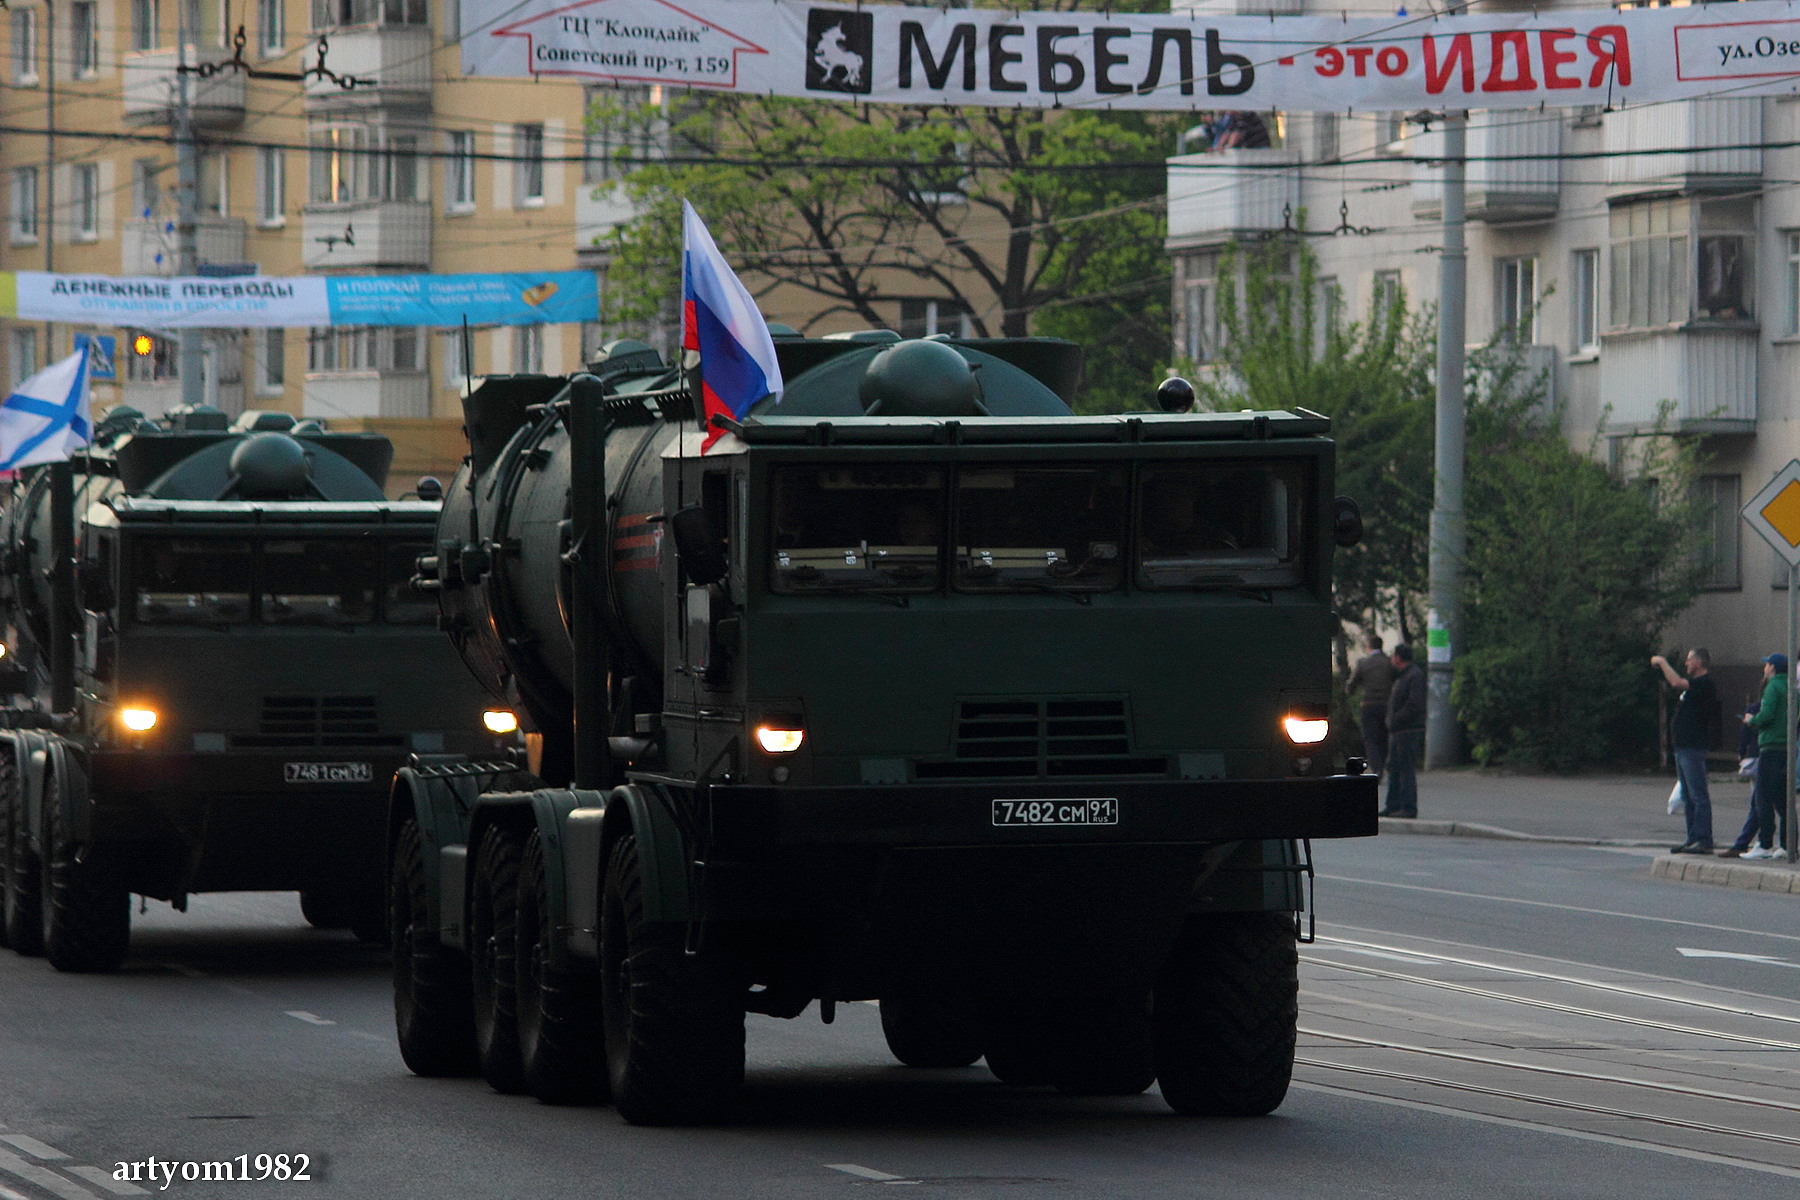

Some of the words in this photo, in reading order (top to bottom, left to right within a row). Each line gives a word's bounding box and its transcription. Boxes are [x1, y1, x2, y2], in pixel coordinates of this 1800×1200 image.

[559, 15, 589, 39] ТЦ
[536, 44, 637, 67] Советский
[695, 56, 730, 74] 159
[899, 21, 1256, 96] МЕБЕЛЬ
[1314, 46, 1409, 78] это
[1422, 25, 1632, 94] ИДЕЯ
[52, 279, 172, 298] ДЕНЕЖНЫЕ
[181, 280, 294, 298] ПЕРЕВОДЫ
[1001, 802, 1055, 823] 7482
[1058, 806, 1085, 822] СМ
[1090, 801, 1110, 816] 91
